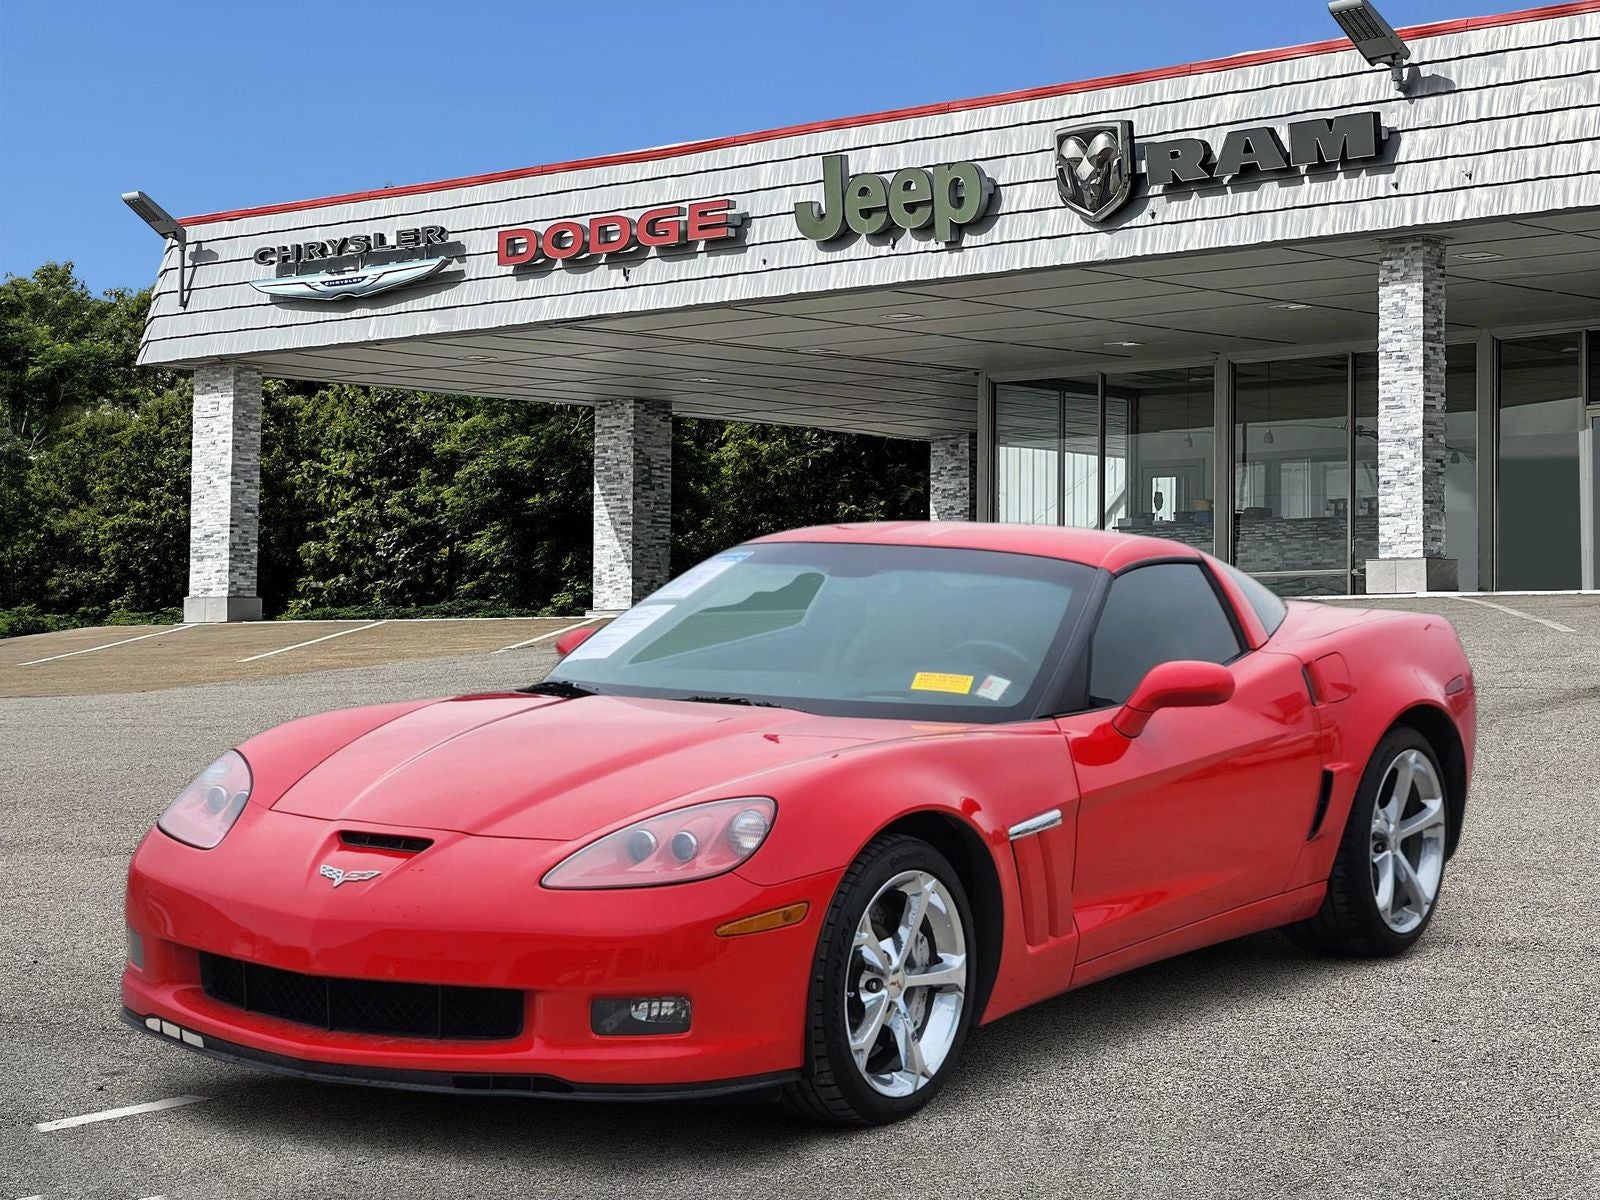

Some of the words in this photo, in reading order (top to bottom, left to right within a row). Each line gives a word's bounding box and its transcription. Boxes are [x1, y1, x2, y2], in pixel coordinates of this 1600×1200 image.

[1144, 111, 1380, 187] RAM
[497, 199, 733, 267] DODGE
[794, 154, 984, 243] Jeep
[254, 225, 448, 266] CHRYSLER
